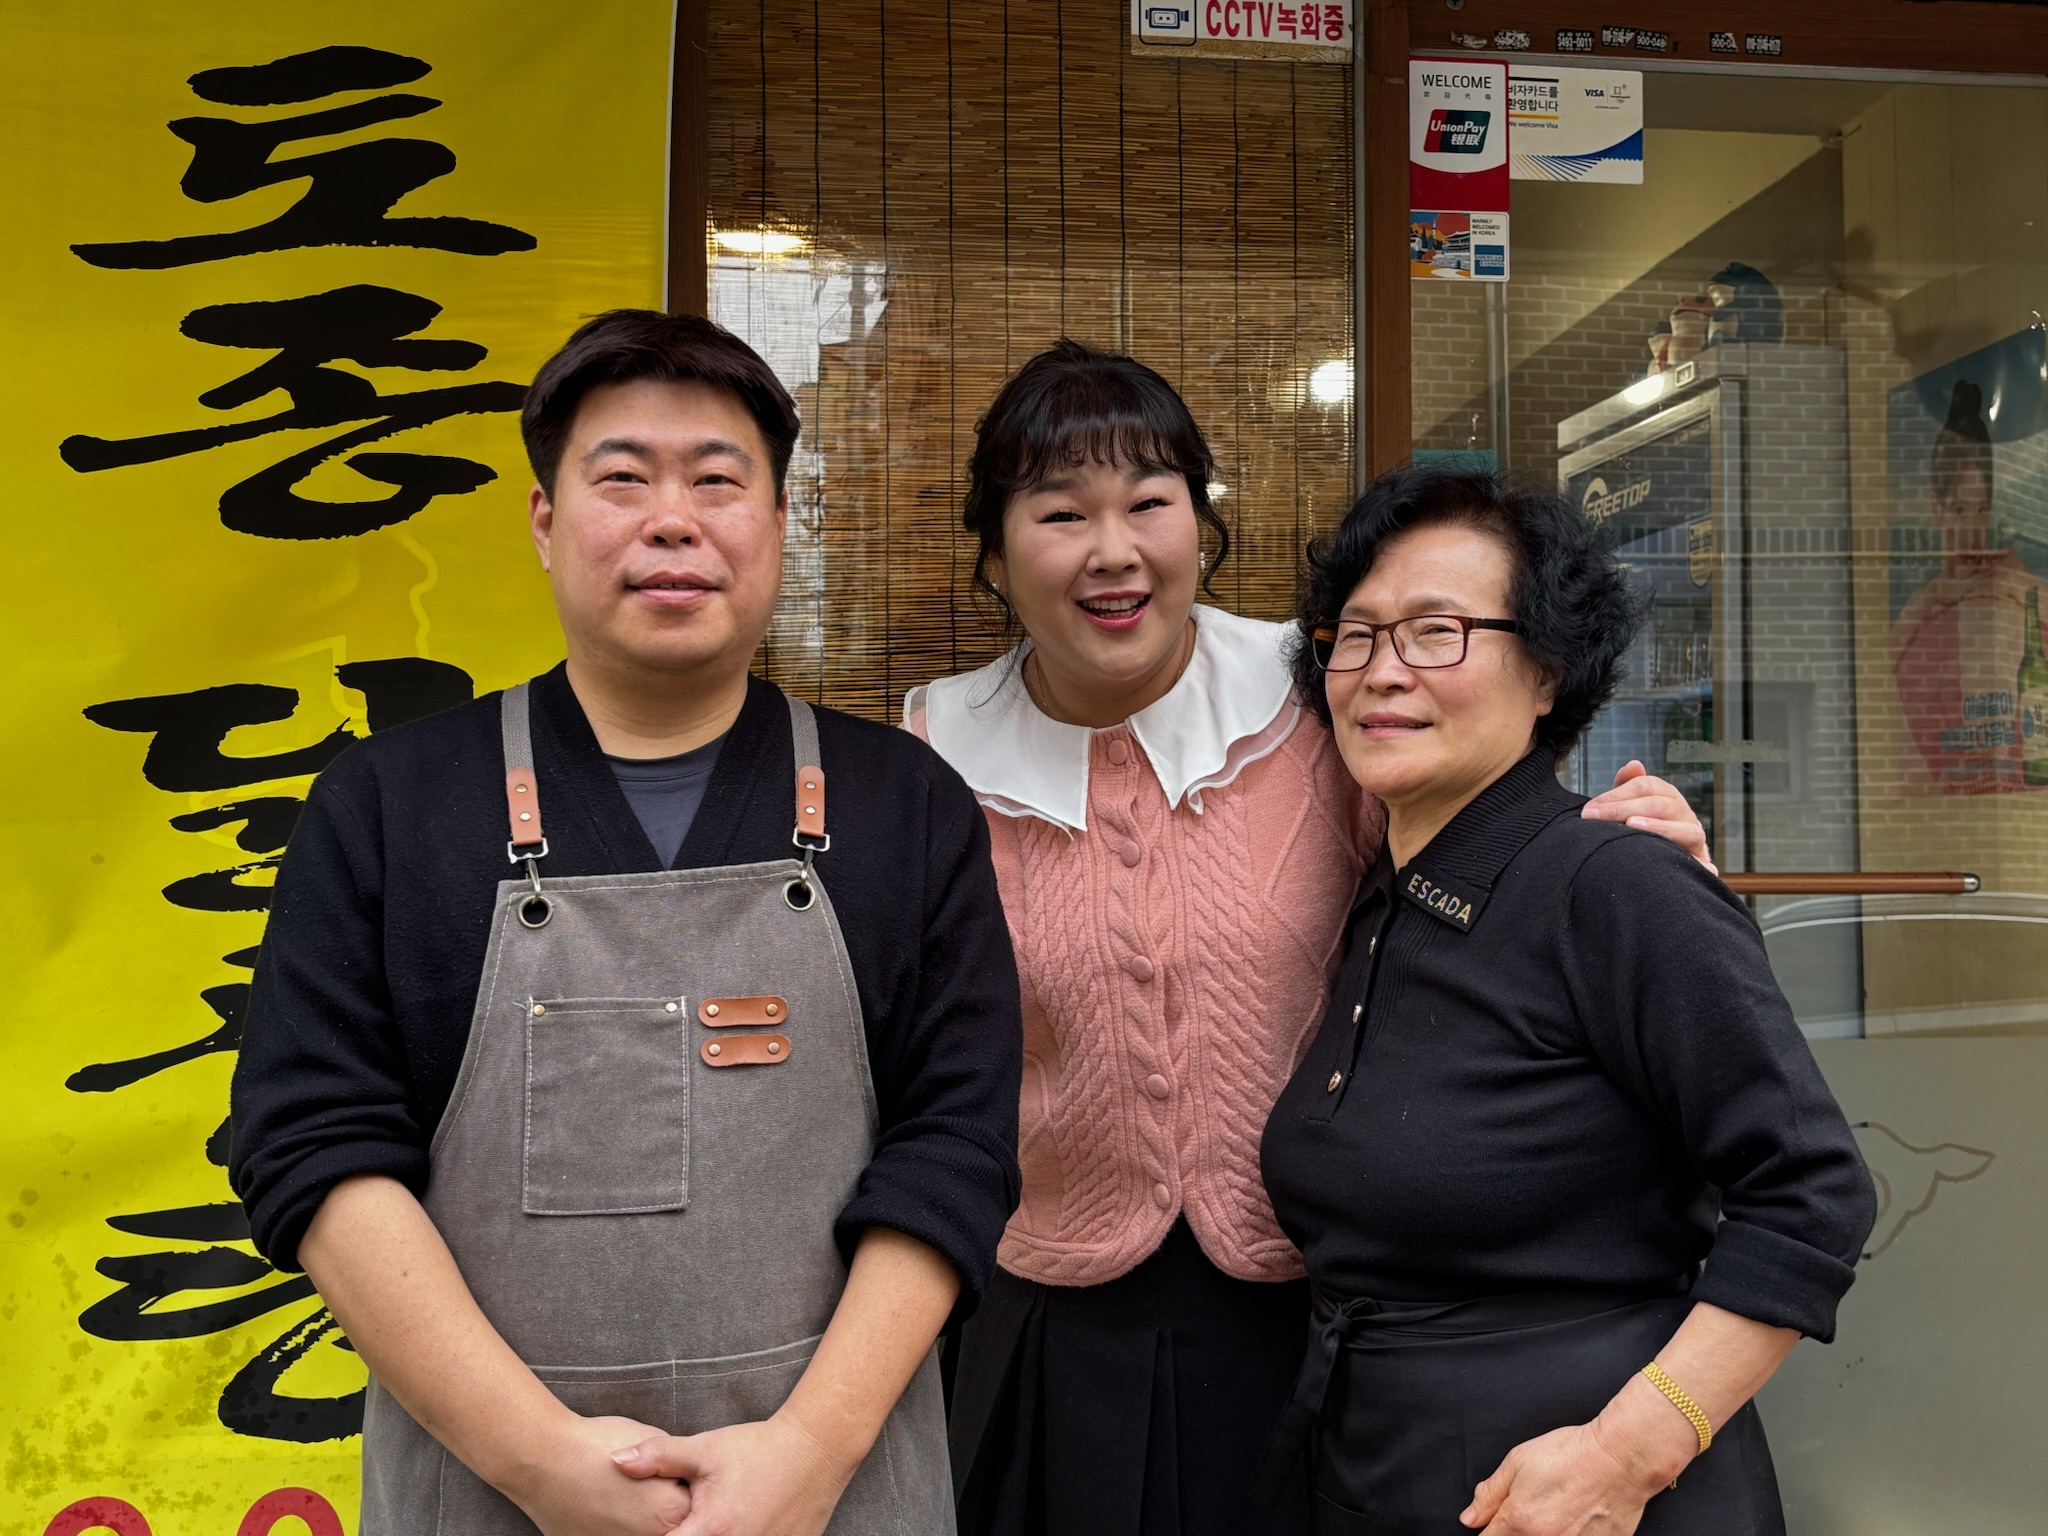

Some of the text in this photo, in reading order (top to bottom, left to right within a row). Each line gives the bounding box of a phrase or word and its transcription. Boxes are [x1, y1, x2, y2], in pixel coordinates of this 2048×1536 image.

[1421, 74, 1492, 89] WELCOME
[1584, 88, 1605, 97] VISA
[1430, 120, 1487, 137] UnionPay
[59, 46, 538, 541] 토종
[1407, 873, 1472, 924] ESCADA
